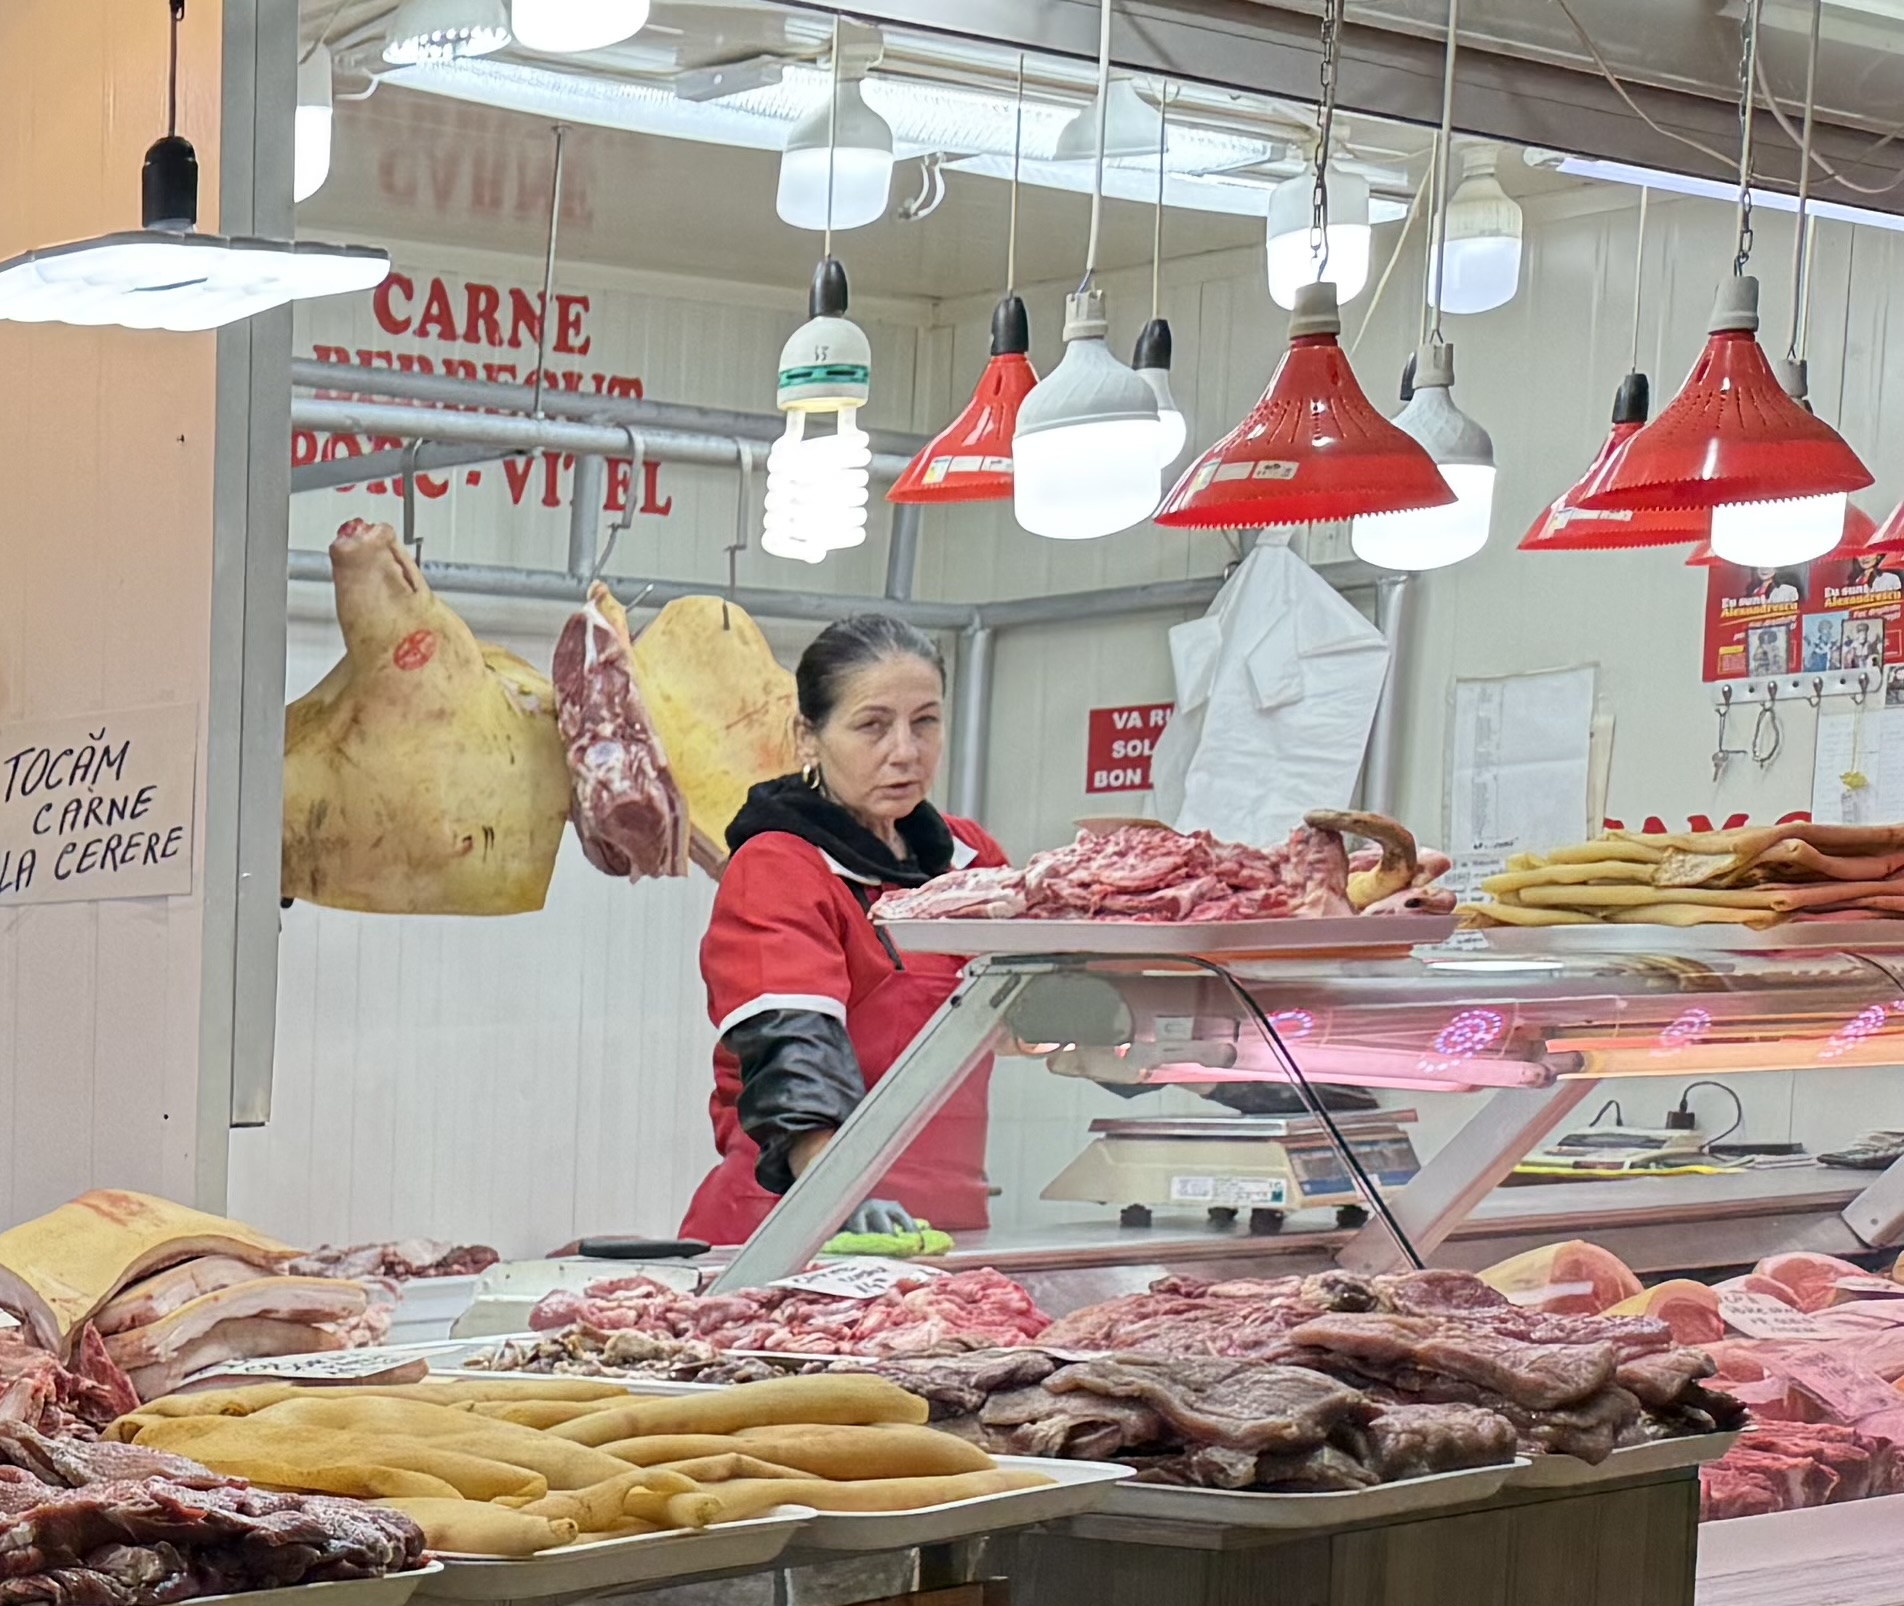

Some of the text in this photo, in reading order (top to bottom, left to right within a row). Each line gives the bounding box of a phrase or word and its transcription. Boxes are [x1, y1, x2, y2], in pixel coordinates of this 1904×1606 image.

[373, 272, 591, 356] CARNE
[504, 450, 673, 517] VIEL
[1112, 710, 1143, 729] VA
[4, 727, 130, 802] TOCĂM
[1094, 768, 1142, 788] BON
[33, 785, 157, 835] CARNE
[54, 826, 183, 880] CERERE
